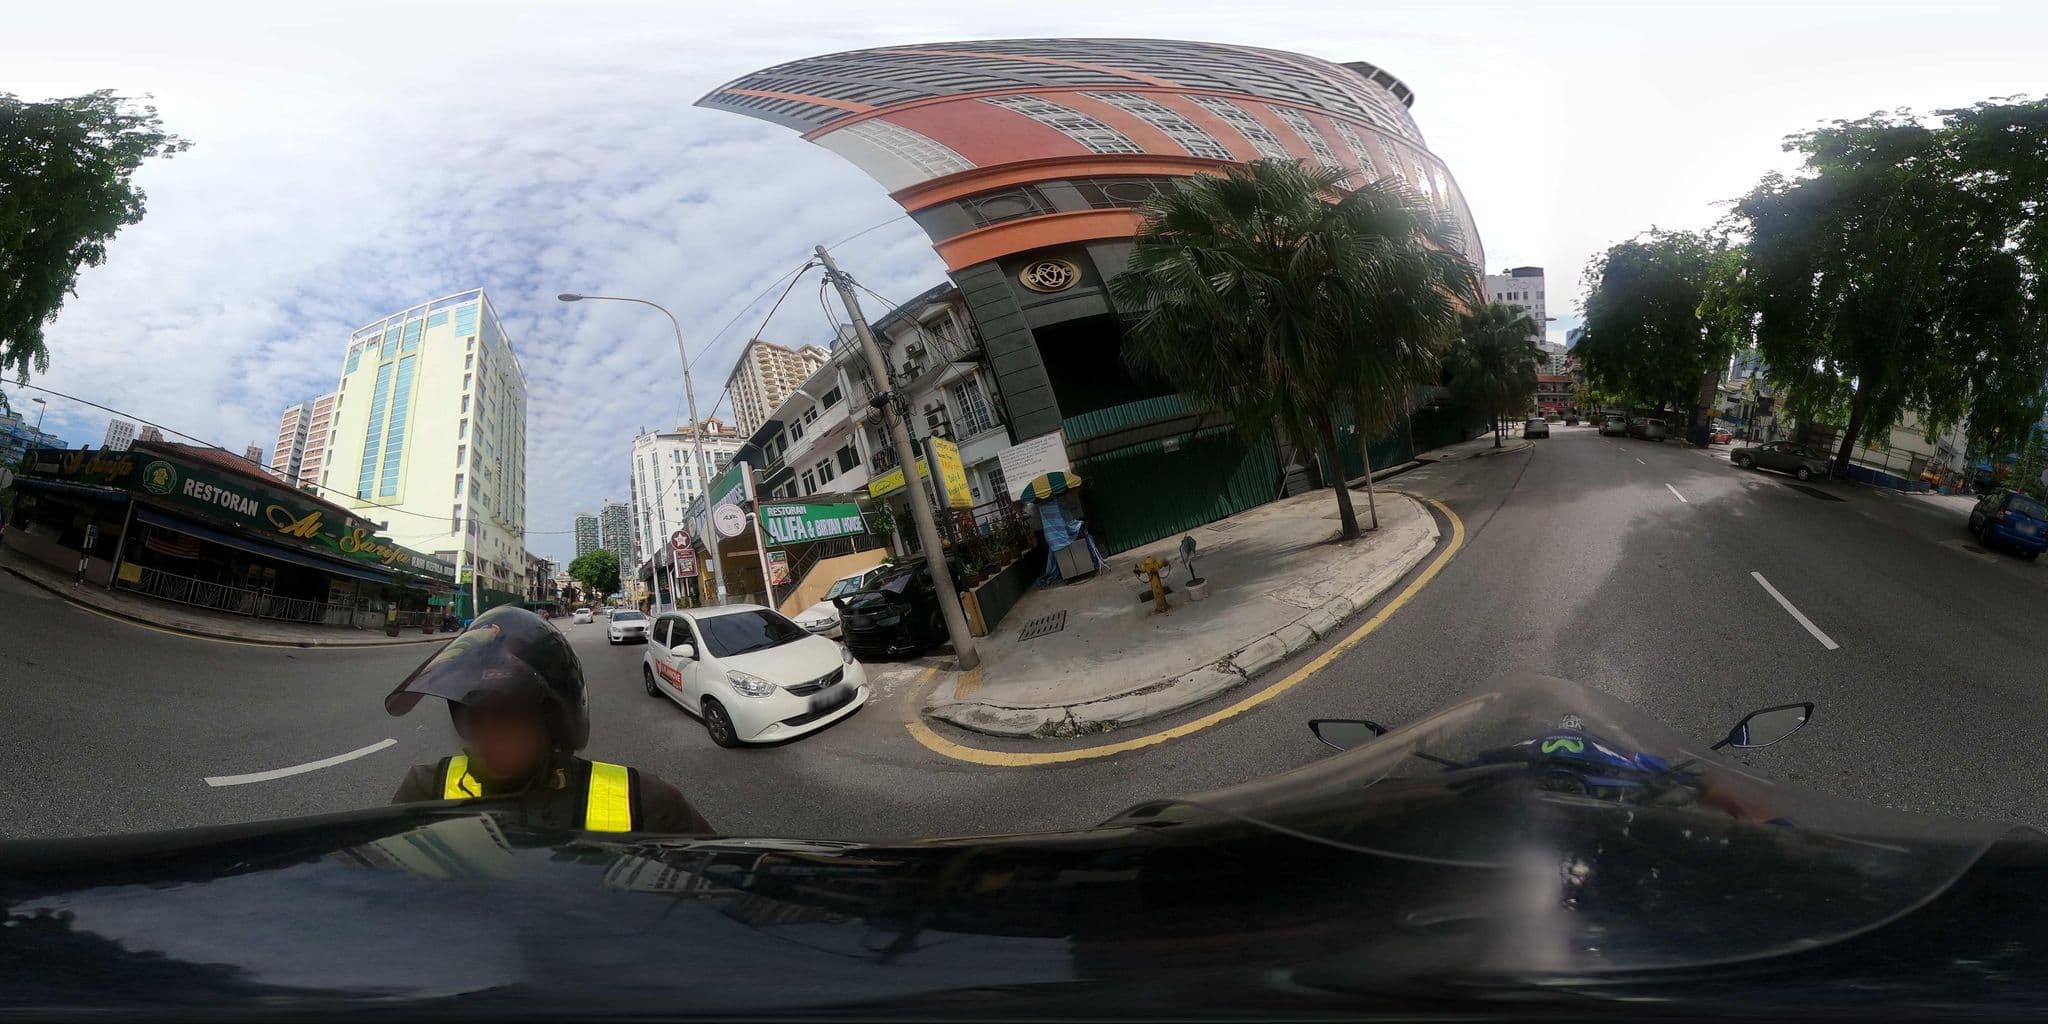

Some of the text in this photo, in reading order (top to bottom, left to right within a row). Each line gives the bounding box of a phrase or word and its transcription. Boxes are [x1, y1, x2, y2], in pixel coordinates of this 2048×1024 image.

[183, 478, 259, 517] RESTORAN
[766, 505, 807, 517] RESTORAN
[768, 516, 808, 544] ALIFA
[806, 520, 815, 539] &
